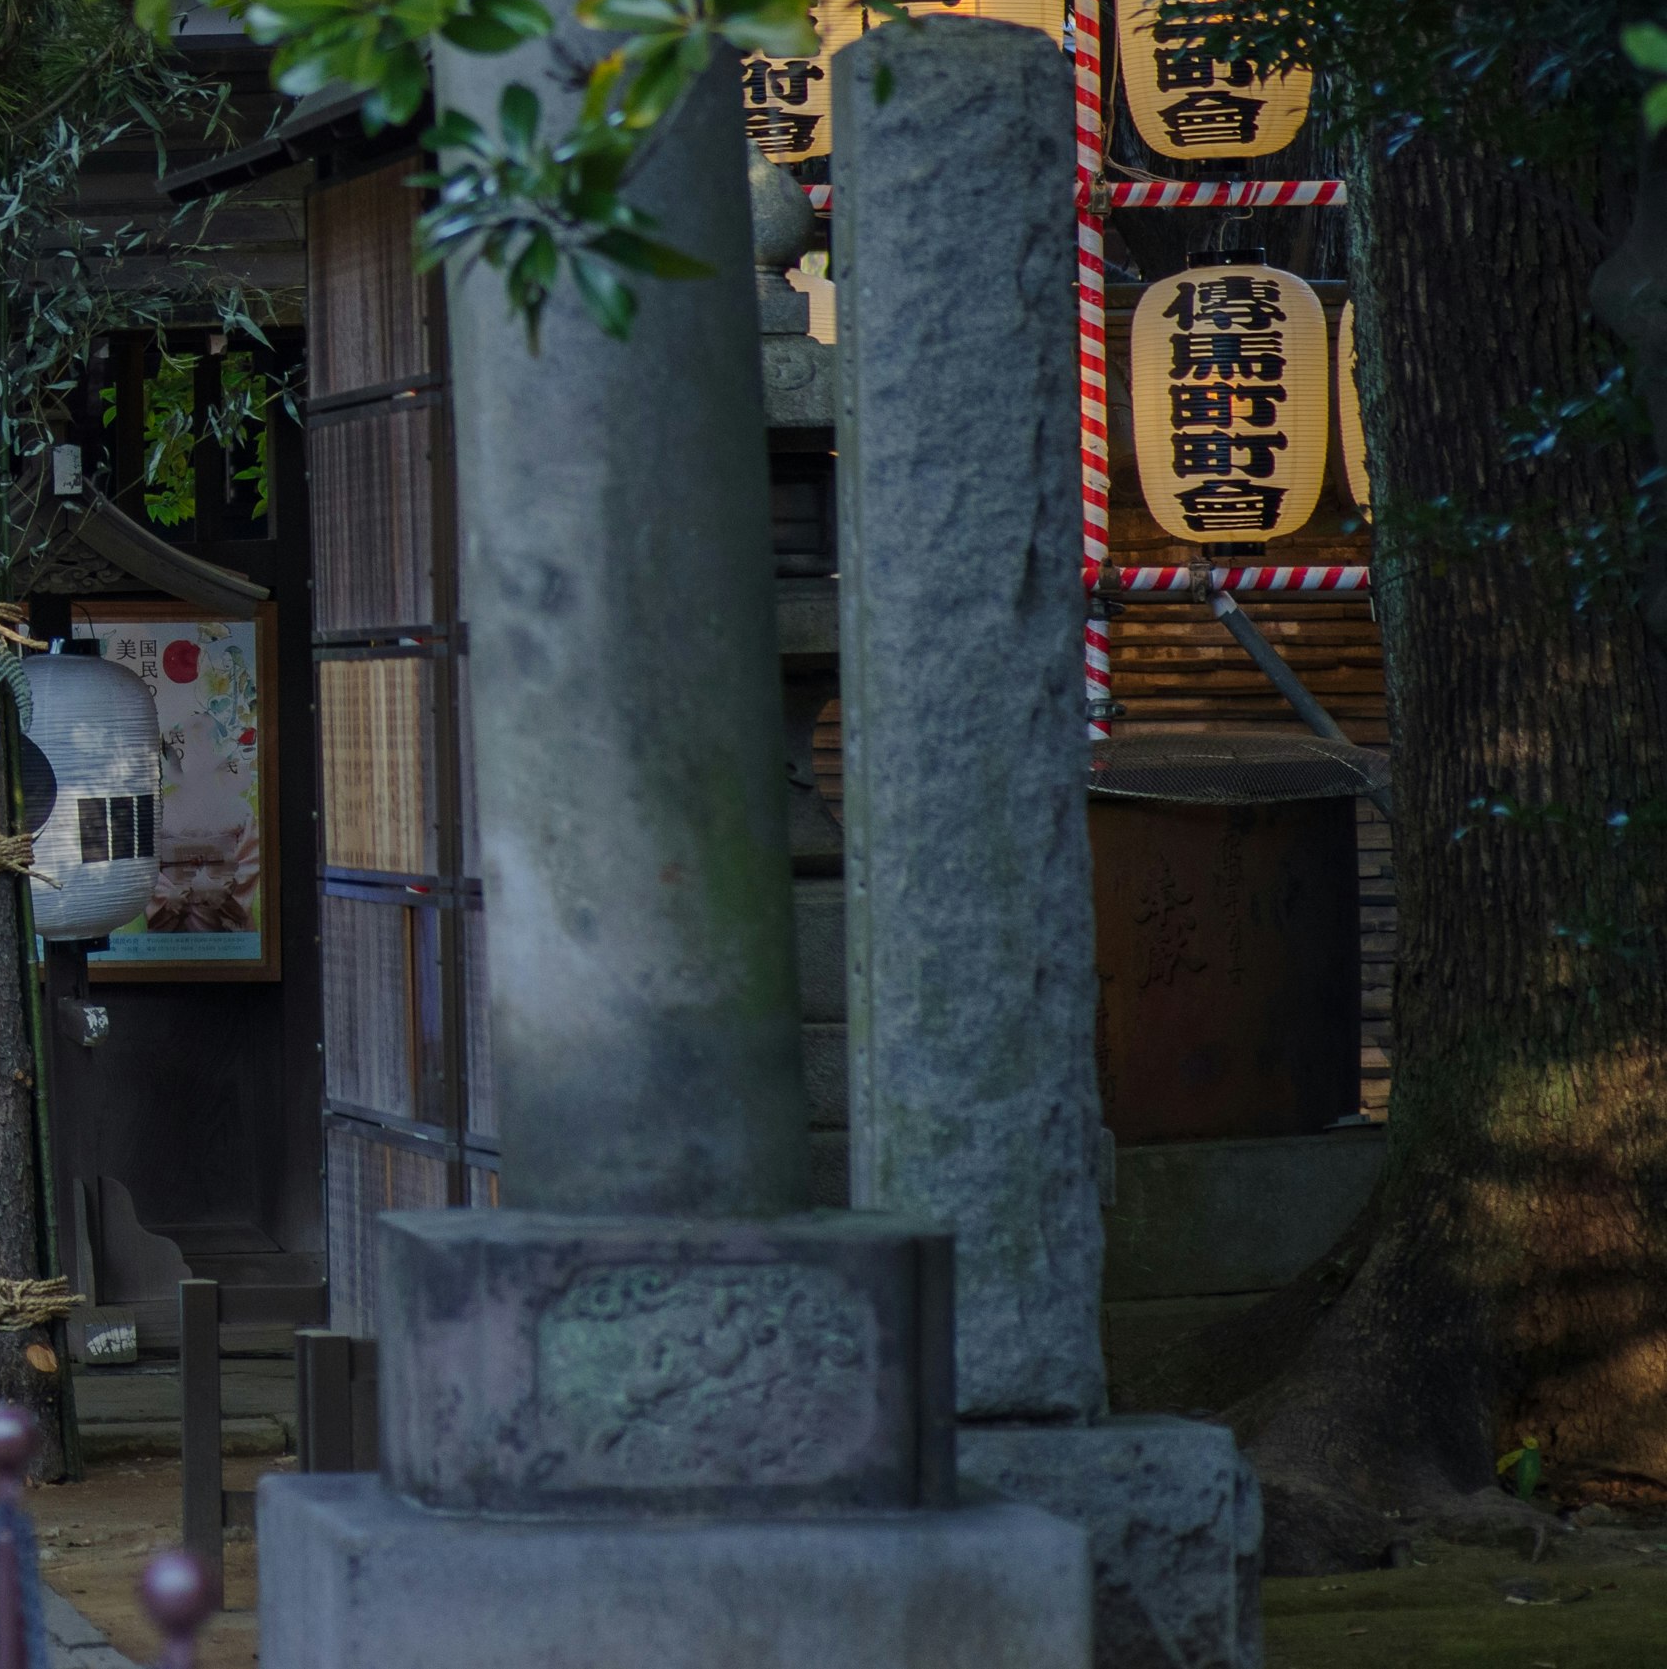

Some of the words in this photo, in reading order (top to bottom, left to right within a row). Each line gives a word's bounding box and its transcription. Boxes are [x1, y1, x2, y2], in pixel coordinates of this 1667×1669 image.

[1162, 275, 1291, 533] 傳馬町町會
